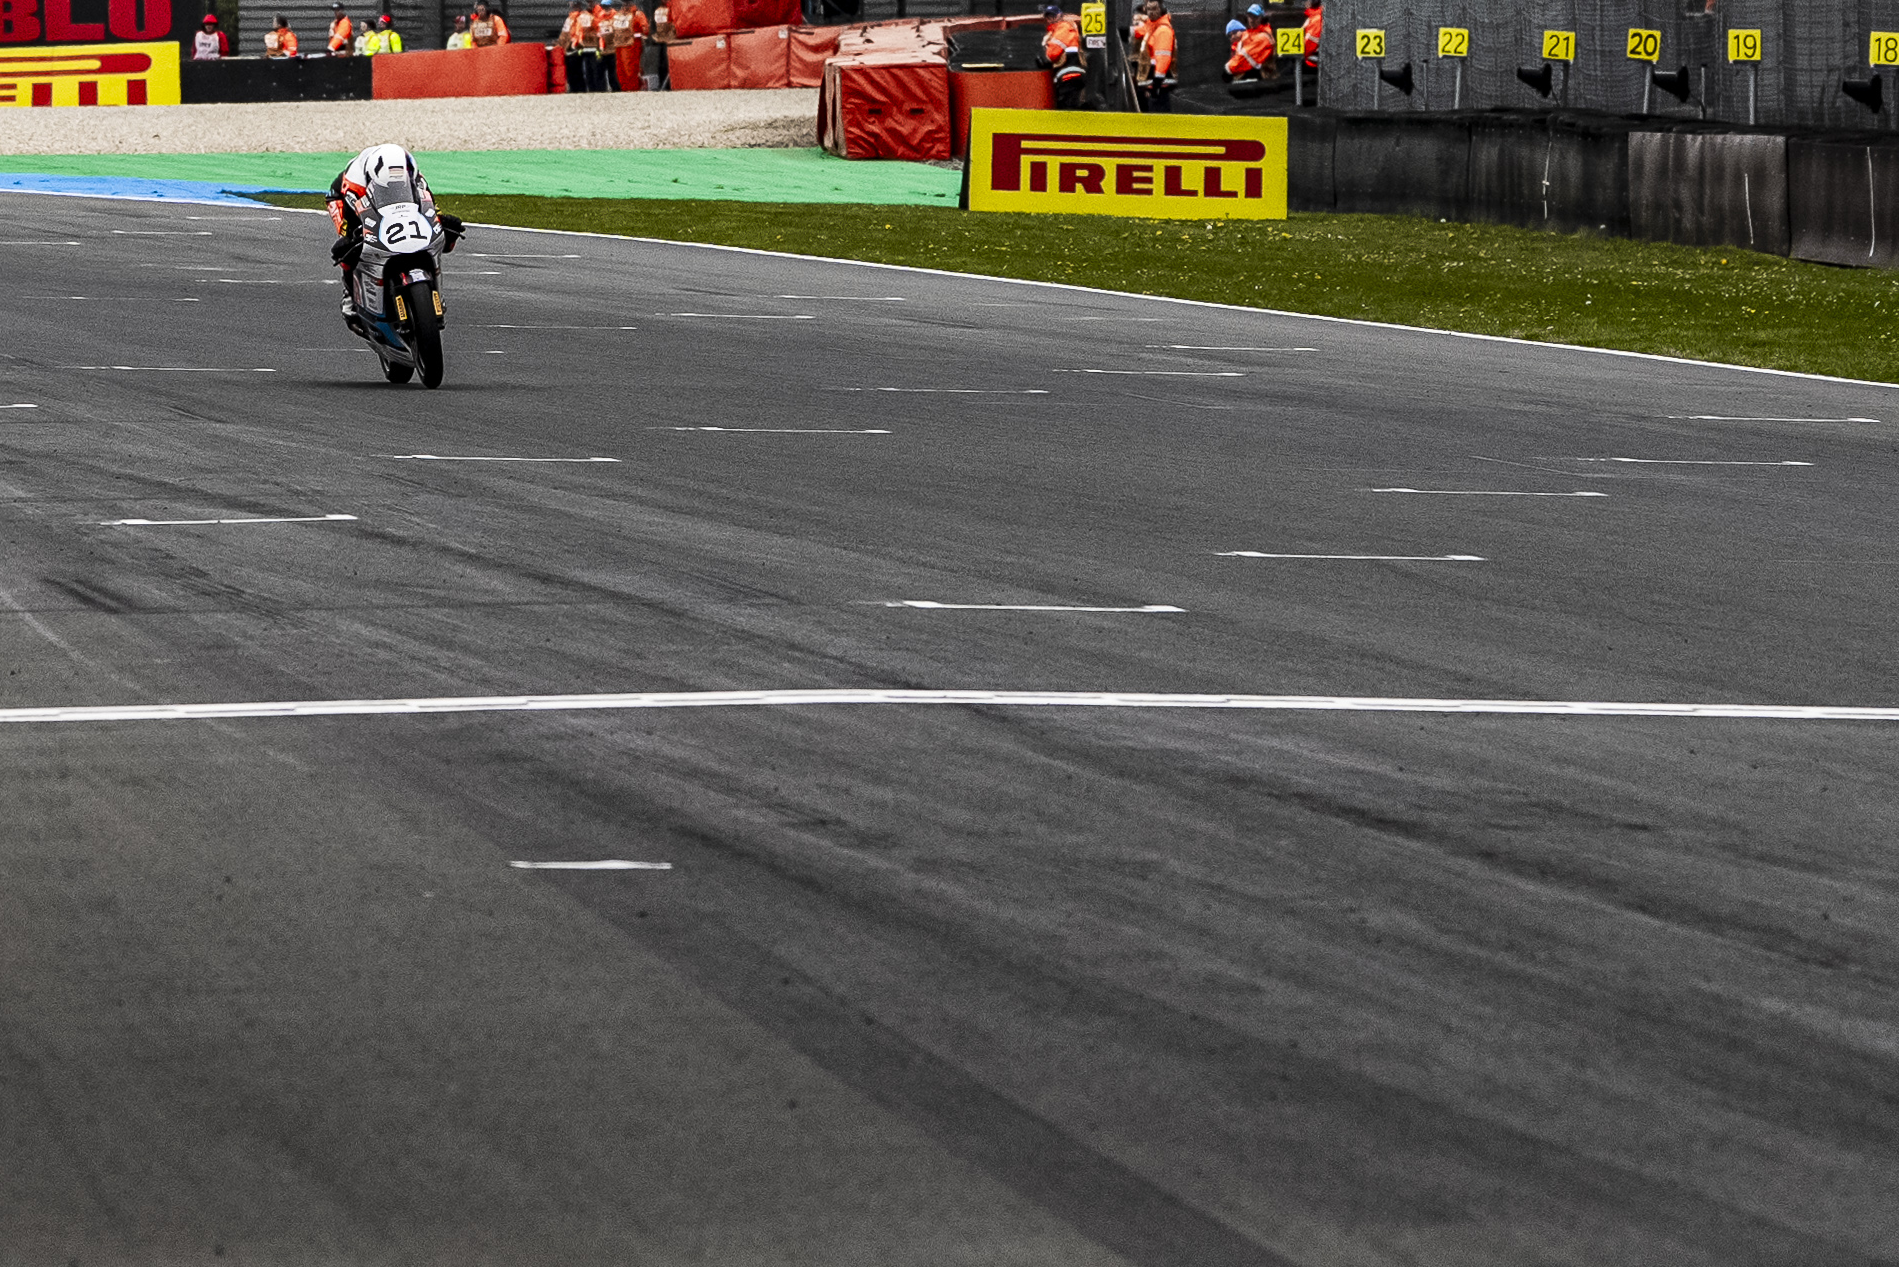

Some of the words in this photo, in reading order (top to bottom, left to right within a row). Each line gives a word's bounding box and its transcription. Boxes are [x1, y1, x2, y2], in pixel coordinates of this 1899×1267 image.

[1084, 14, 1103, 33] 25
[1280, 33, 1301, 53] 24
[1360, 34, 1383, 55] 23
[1441, 32, 1465, 54] 22
[1548, 34, 1569, 57] 21
[1629, 32, 1657, 57] 20
[1733, 34, 1757, 58] 19
[1875, 37, 1898, 63] 18
[991, 133, 1266, 198] PIRELLI
[385, 220, 428, 245] 21
